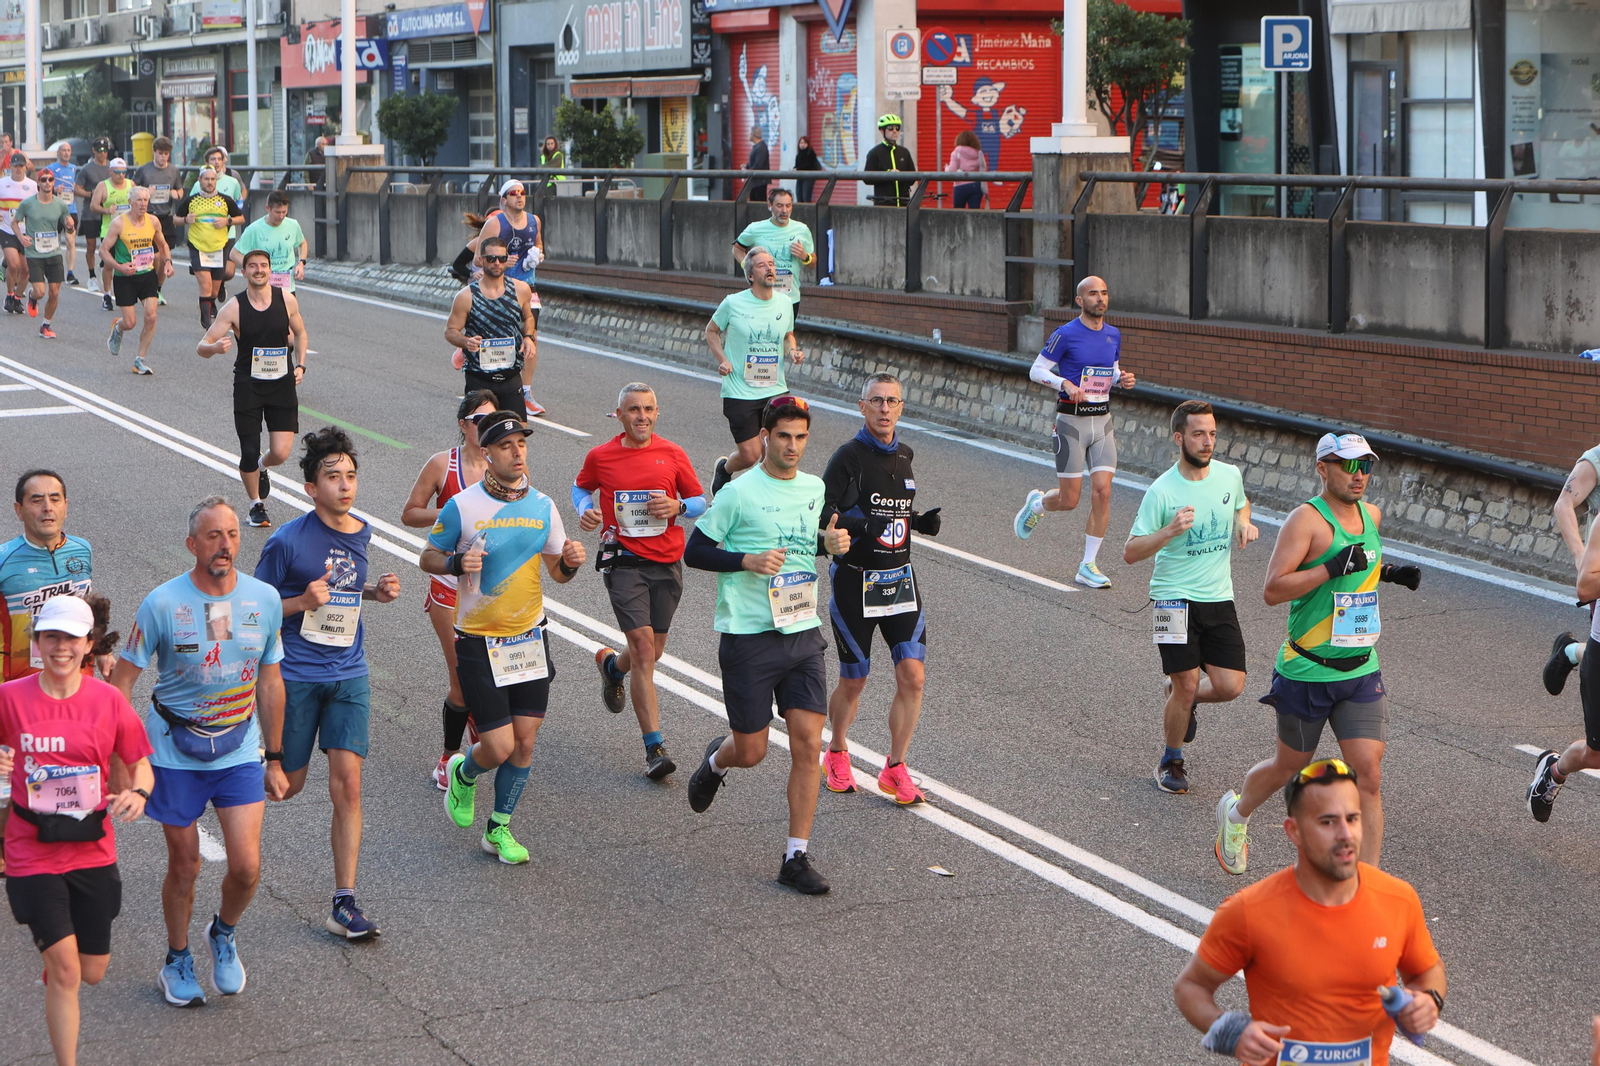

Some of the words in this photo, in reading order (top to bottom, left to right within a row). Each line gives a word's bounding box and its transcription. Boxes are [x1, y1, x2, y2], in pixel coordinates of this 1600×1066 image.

[401, 14, 433, 32] AUTOCLIMA
[975, 33, 1020, 52] Jiménez
[1021, 32, 1052, 48] Maña
[1283, 52, 1309, 60] ARJONA
[976, 59, 1035, 70] RECAMBIOS
[869, 492, 912, 510] George
[474, 516, 545, 531] CANARIAS
[882, 570, 906, 580] ZURICH
[40, 582, 72, 601] TRAIL
[788, 591, 803, 602] 8831
[331, 595, 356, 605] ZURICH
[1353, 595, 1376, 605] ZURICH
[780, 606, 793, 614] LUIS
[326, 613, 345, 623] 9522
[320, 623, 345, 634] EMILITO
[505, 632, 535, 645] ZURICH
[508, 650, 527, 661] 9991
[502, 664, 519, 673] VERA
[519, 662, 524, 670] Y
[524, 660, 537, 669] JAVI
[20, 732, 66, 753] Run
[23, 755, 39, 774] &
[51, 765, 91, 778] ZURICH
[54, 785, 78, 797] 7064
[55, 800, 81, 809] FILIPA
[1313, 1047, 1362, 1062] ZURICH
